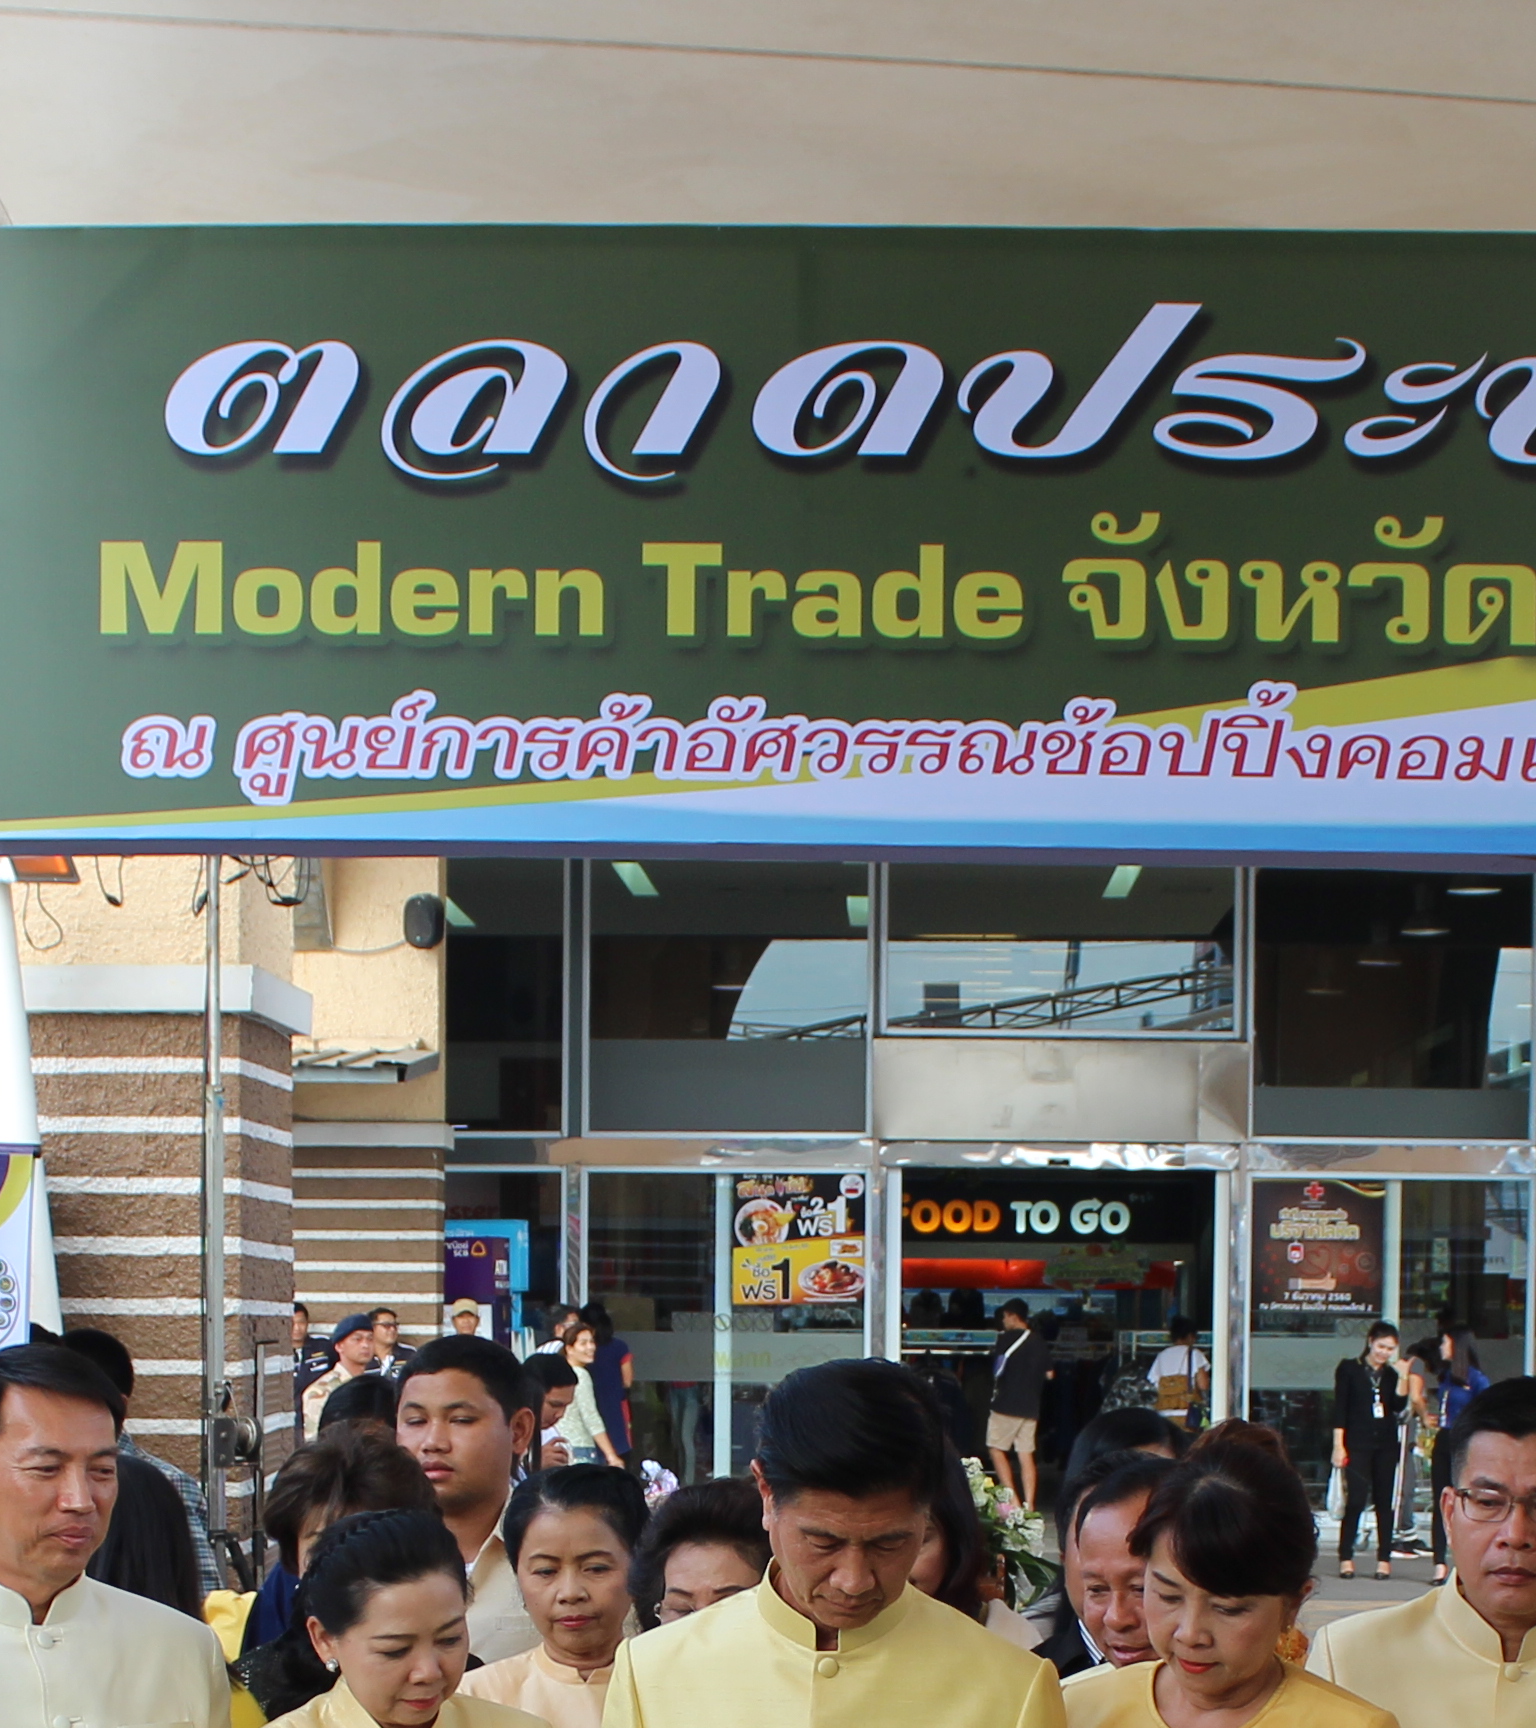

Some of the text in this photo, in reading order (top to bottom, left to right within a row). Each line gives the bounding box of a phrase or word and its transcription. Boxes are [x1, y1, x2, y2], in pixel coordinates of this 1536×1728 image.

[99, 540, 605, 638] Modern
[642, 541, 1025, 639] Trade
[124, 718, 212, 774] ณ
[1010, 1200, 1061, 1234] TO
[1070, 1198, 1131, 1234] GO
